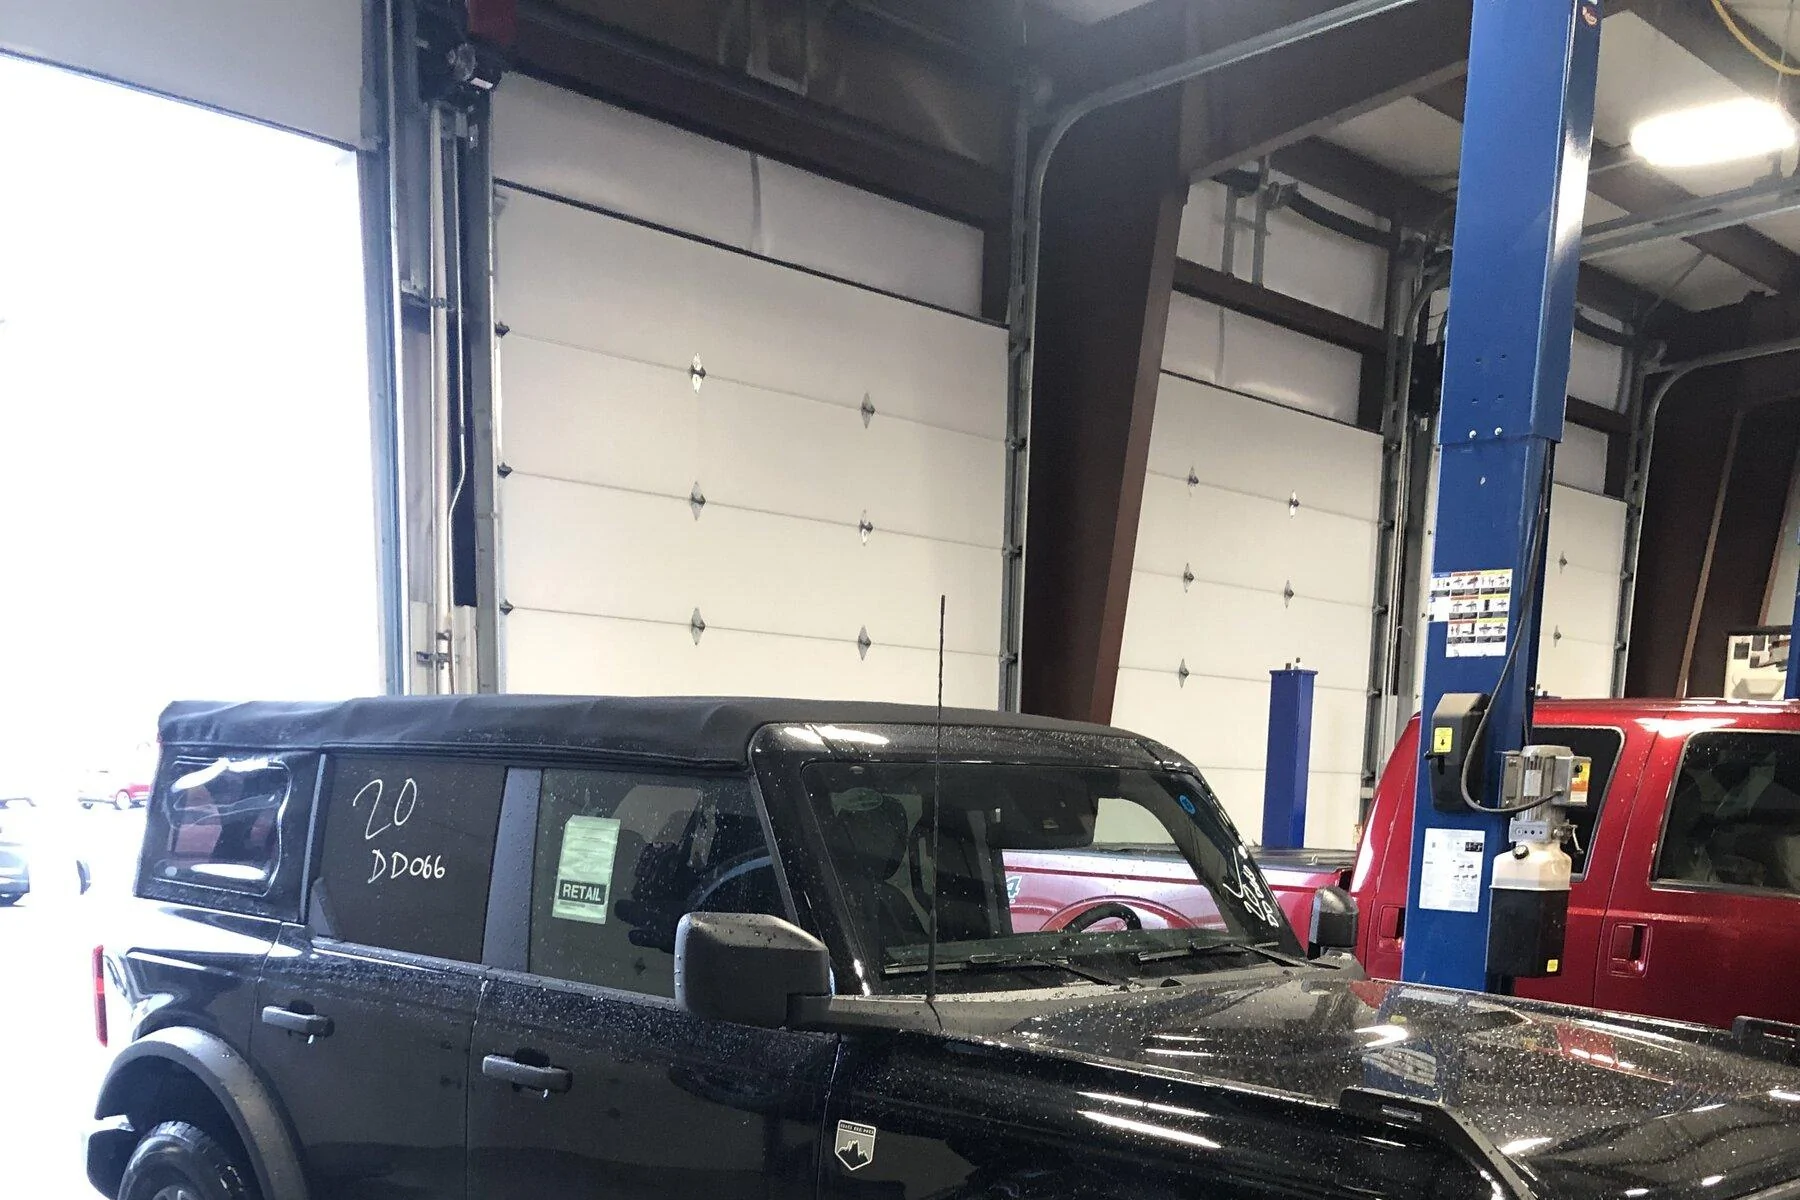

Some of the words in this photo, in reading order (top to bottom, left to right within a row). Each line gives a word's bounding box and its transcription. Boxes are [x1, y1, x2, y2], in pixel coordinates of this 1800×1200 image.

[352, 778, 418, 840] 20
[367, 849, 446, 884] DD066
[562, 883, 602, 902] RETAIL
